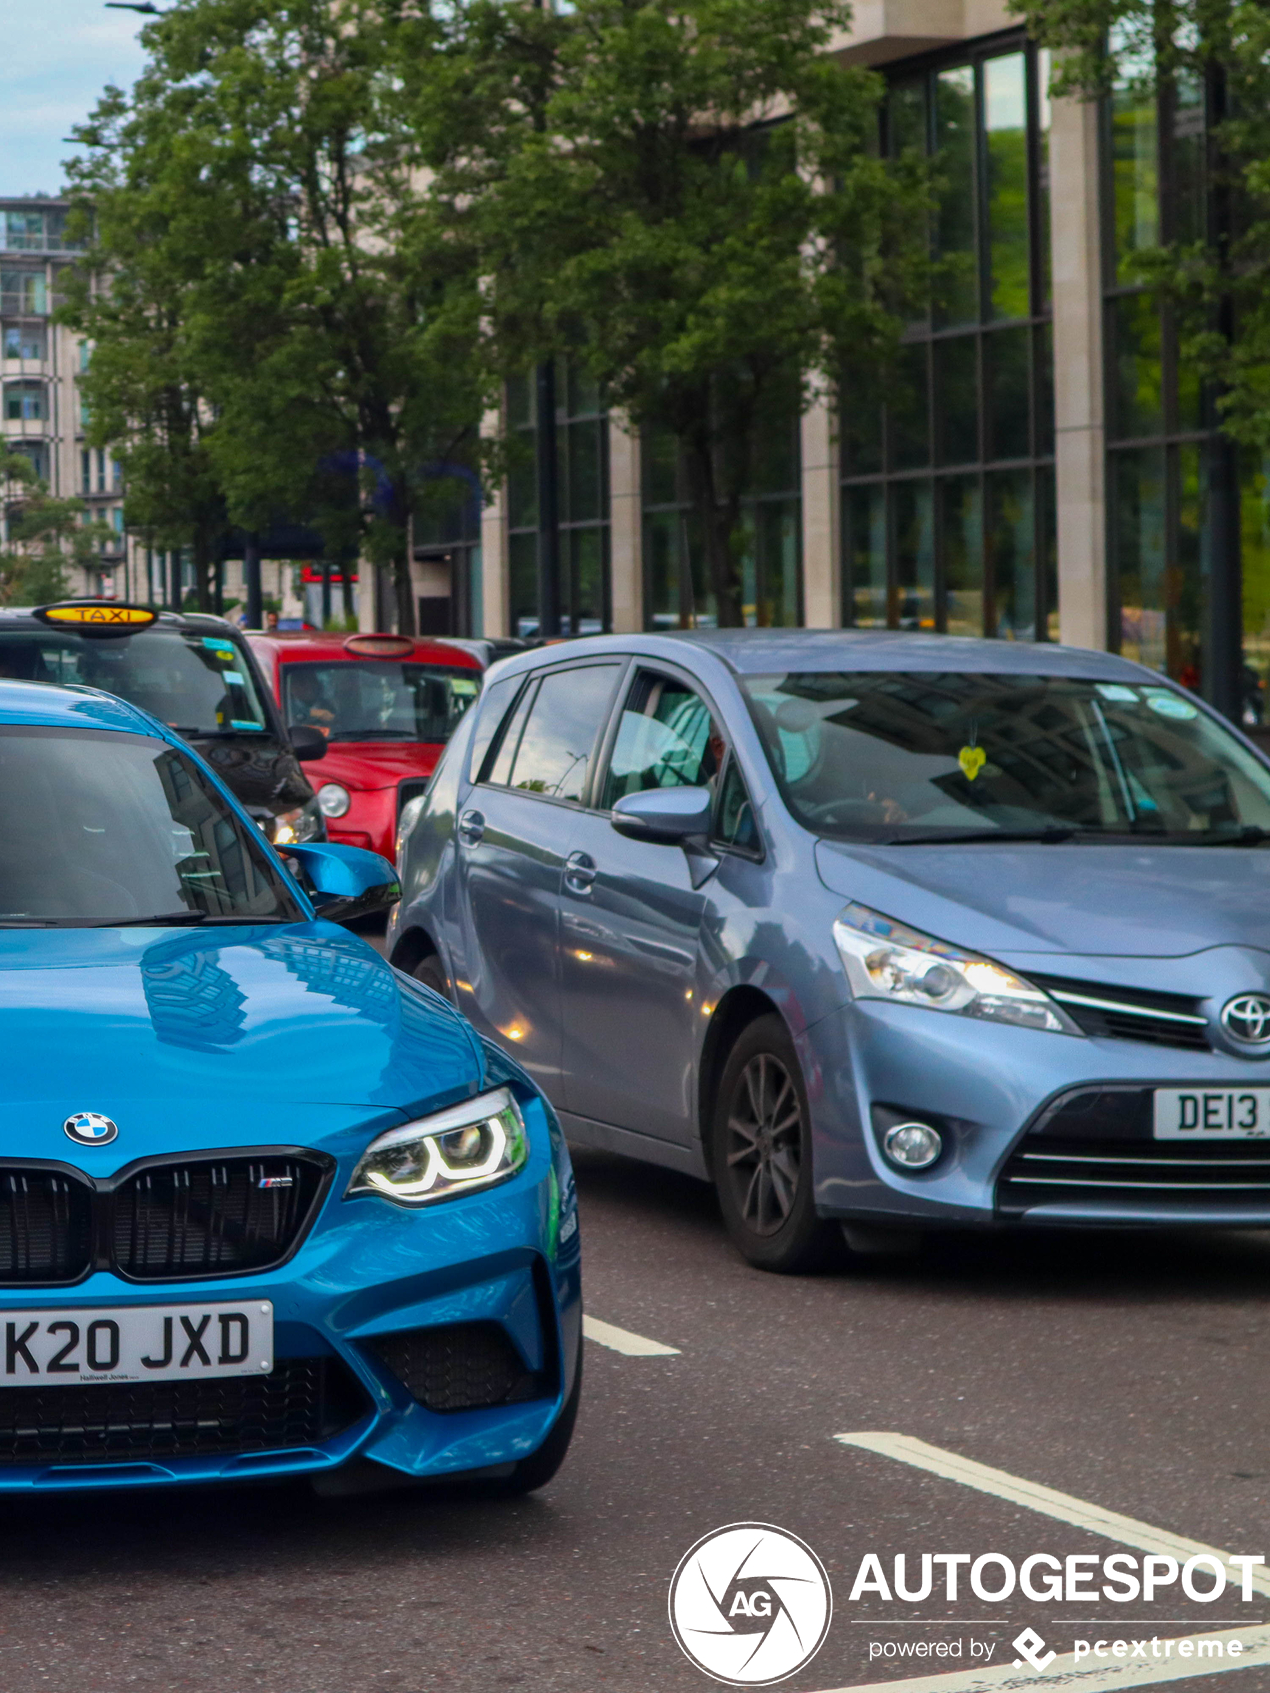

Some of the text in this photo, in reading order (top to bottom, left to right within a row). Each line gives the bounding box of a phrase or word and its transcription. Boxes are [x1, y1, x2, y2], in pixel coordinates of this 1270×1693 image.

[75, 609, 131, 622] TAXI
[1178, 1094, 1258, 1131] DE13
[140, 1312, 250, 1370] JXD
